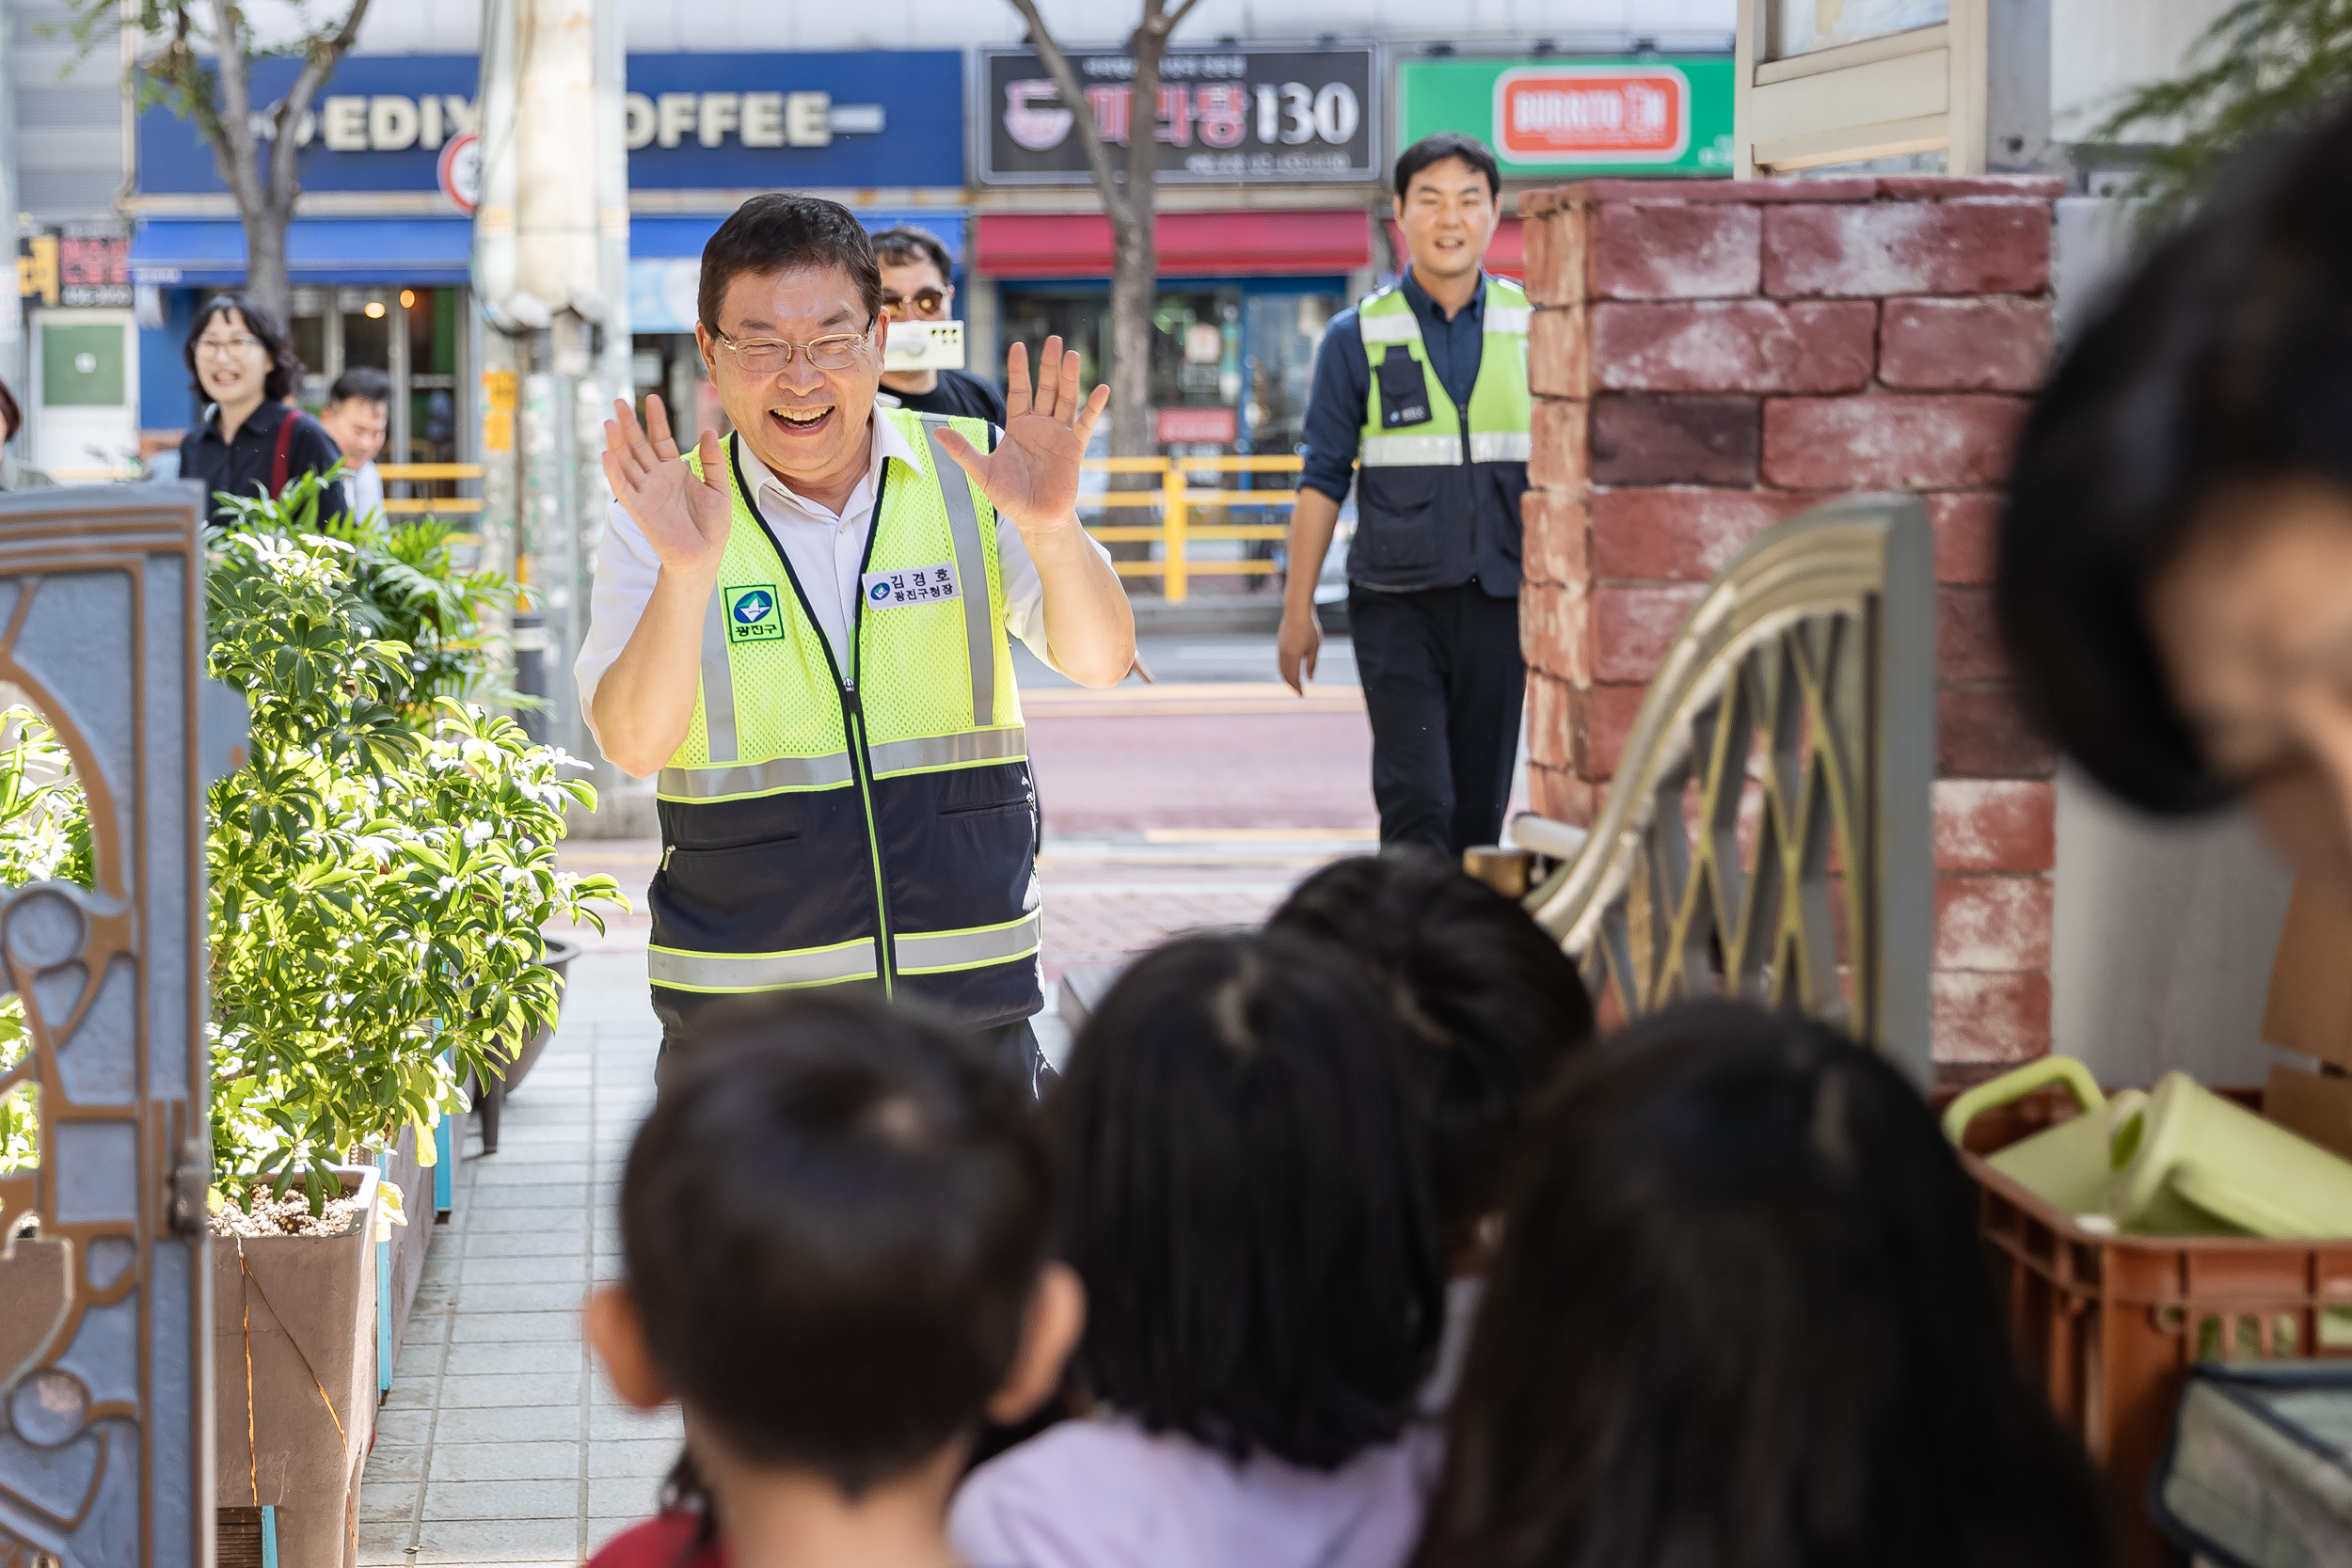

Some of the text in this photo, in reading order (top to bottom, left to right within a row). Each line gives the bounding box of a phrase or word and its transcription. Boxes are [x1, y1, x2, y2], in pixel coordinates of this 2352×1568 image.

[324, 94, 481, 151] EDIY
[627, 90, 833, 150] OFFEE
[1253, 81, 1359, 145] 130
[1513, 89, 1623, 133] BURRITO
[894, 583, 953, 602] 광진구청장
[736, 624, 777, 637] 광진구
